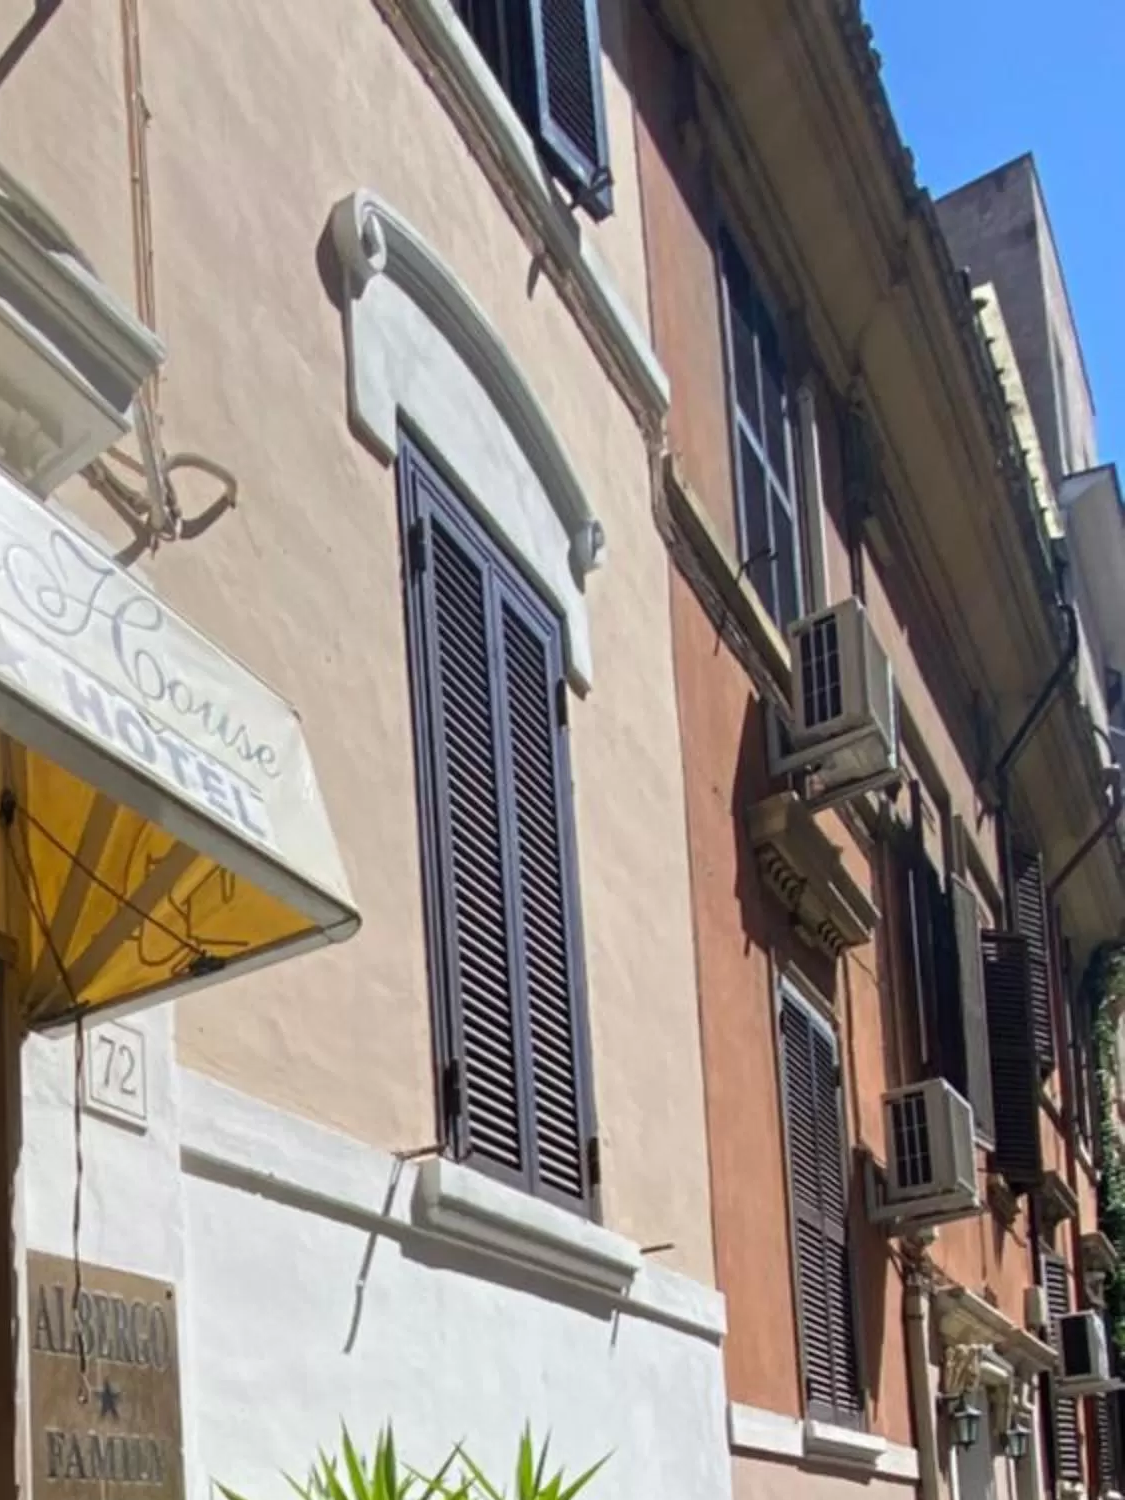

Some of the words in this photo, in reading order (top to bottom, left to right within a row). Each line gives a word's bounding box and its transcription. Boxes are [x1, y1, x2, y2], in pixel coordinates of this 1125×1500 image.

[3, 529, 281, 779] House
[62, 668, 267, 838] HOTEL
[97, 1035, 137, 1095] 72
[33, 1284, 170, 1371] ALBERGO
[45, 1428, 167, 1482] FAMILY
